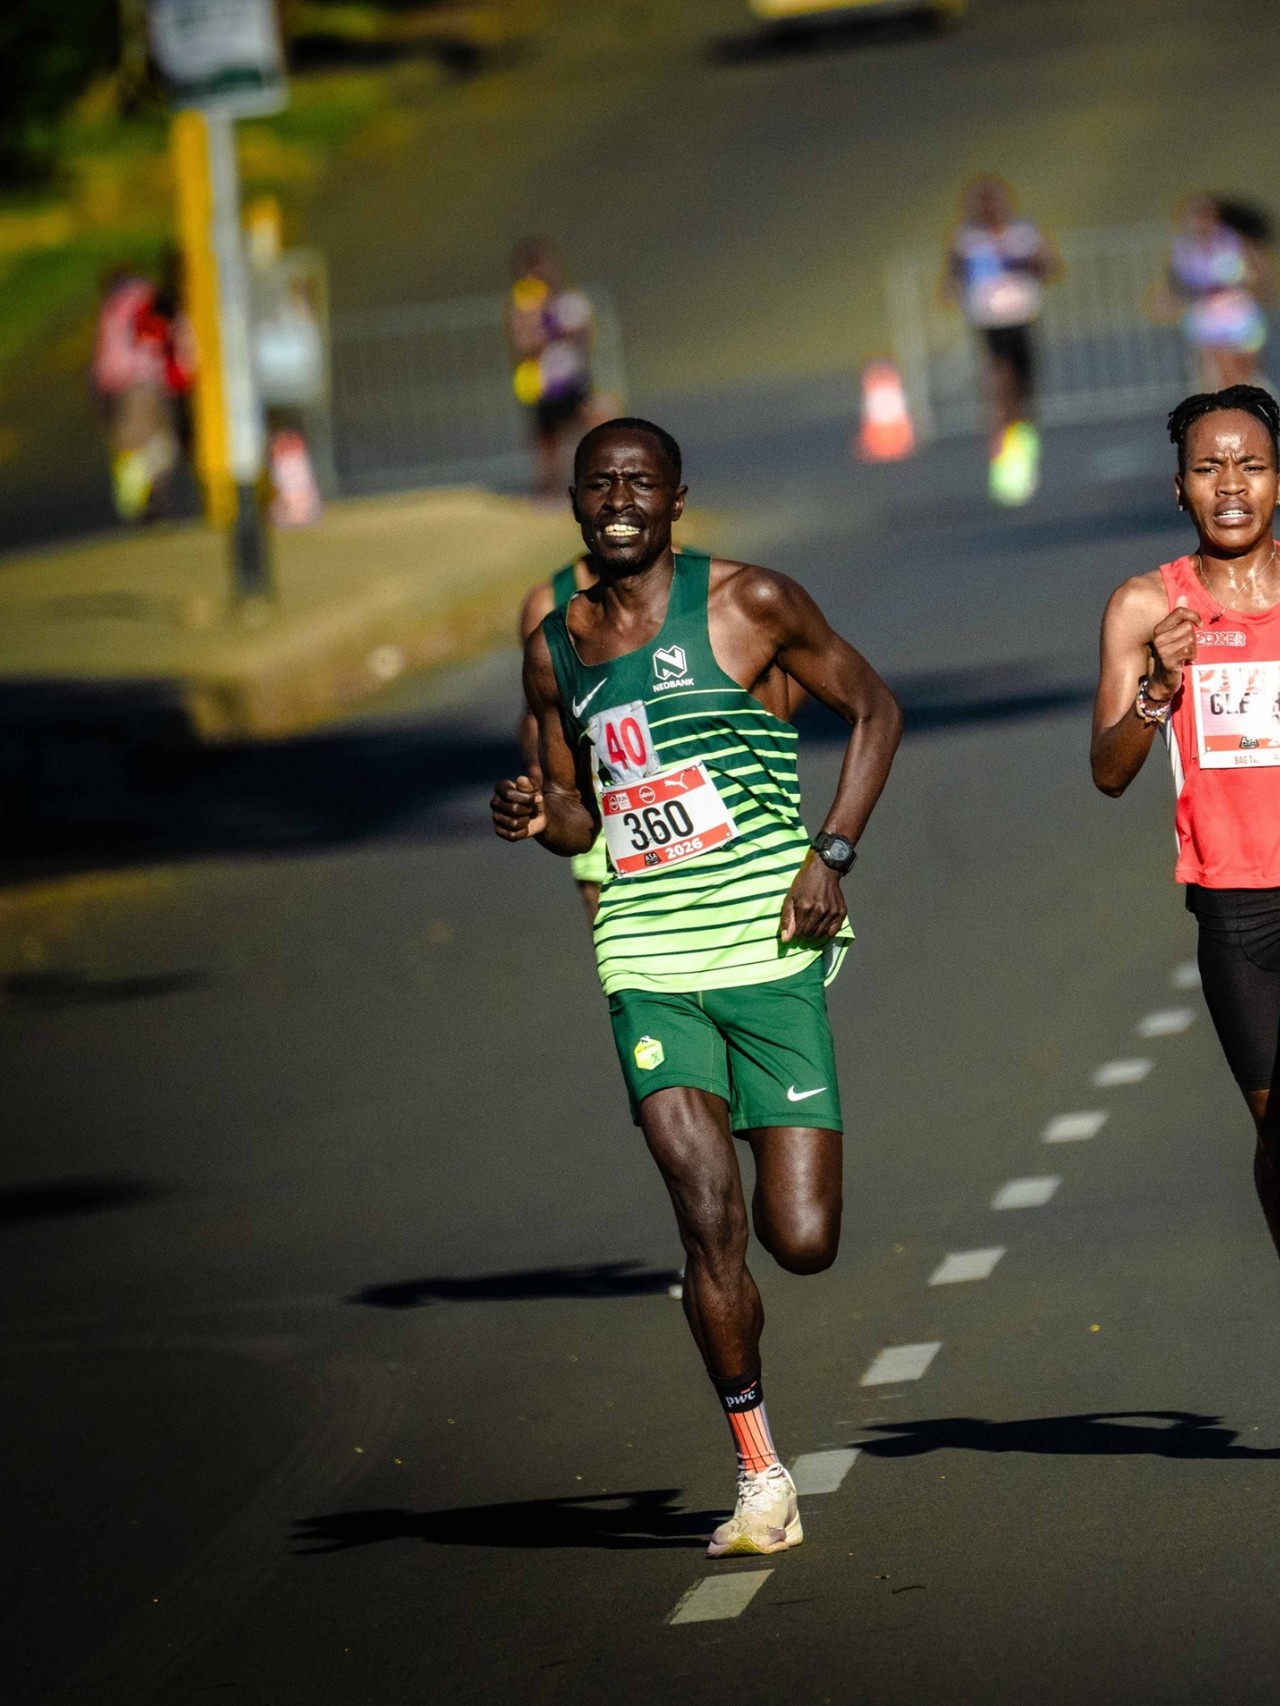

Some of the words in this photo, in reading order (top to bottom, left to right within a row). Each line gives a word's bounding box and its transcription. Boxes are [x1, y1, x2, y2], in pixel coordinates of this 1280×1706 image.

[653, 678, 694, 693] NEDBANK
[605, 716, 647, 772] 40
[623, 800, 694, 851] 360
[664, 838, 703, 860] 2026
[725, 1390, 756, 1408] pwc
